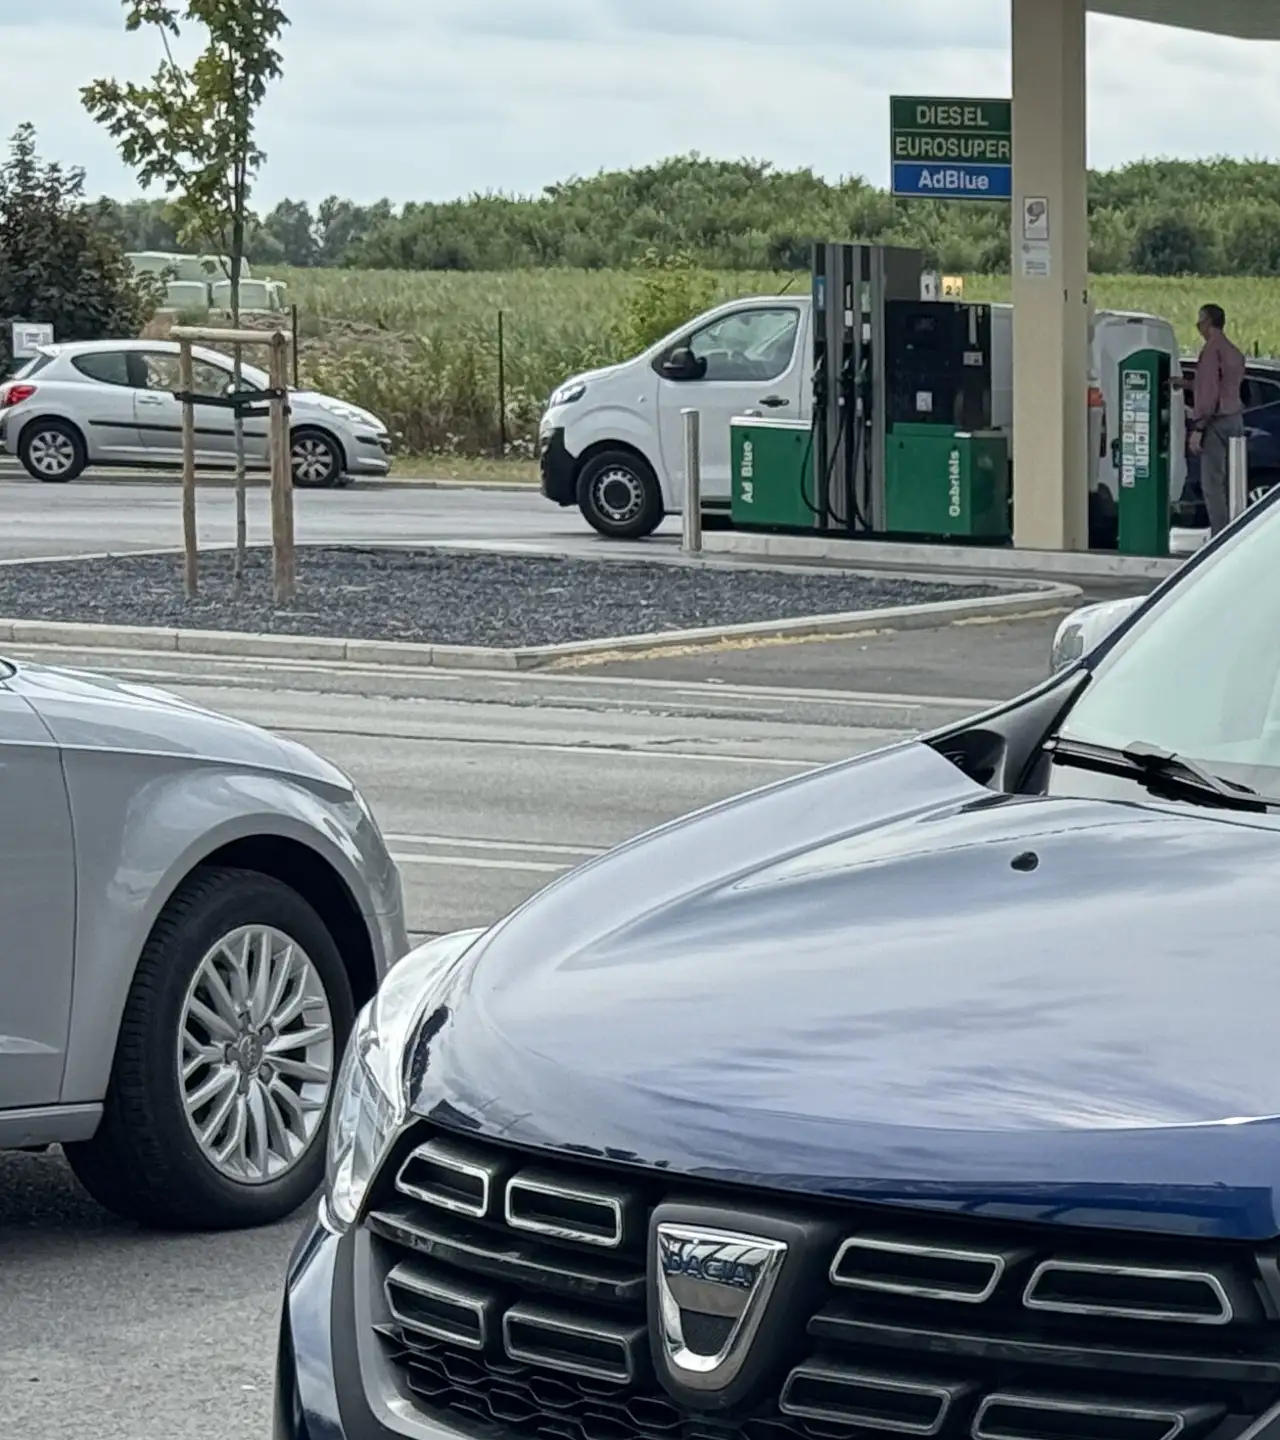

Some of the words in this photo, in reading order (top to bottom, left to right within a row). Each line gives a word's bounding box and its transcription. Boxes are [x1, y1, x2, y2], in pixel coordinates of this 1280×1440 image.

[916, 105, 989, 126] DIESEL
[895, 136, 1011, 158] EUROSUPER
[918, 169, 990, 190] AdBlue
[741, 441, 753, 478] Blue
[741, 481, 753, 504] Ad
[664, 1254, 751, 1288] DACIA
